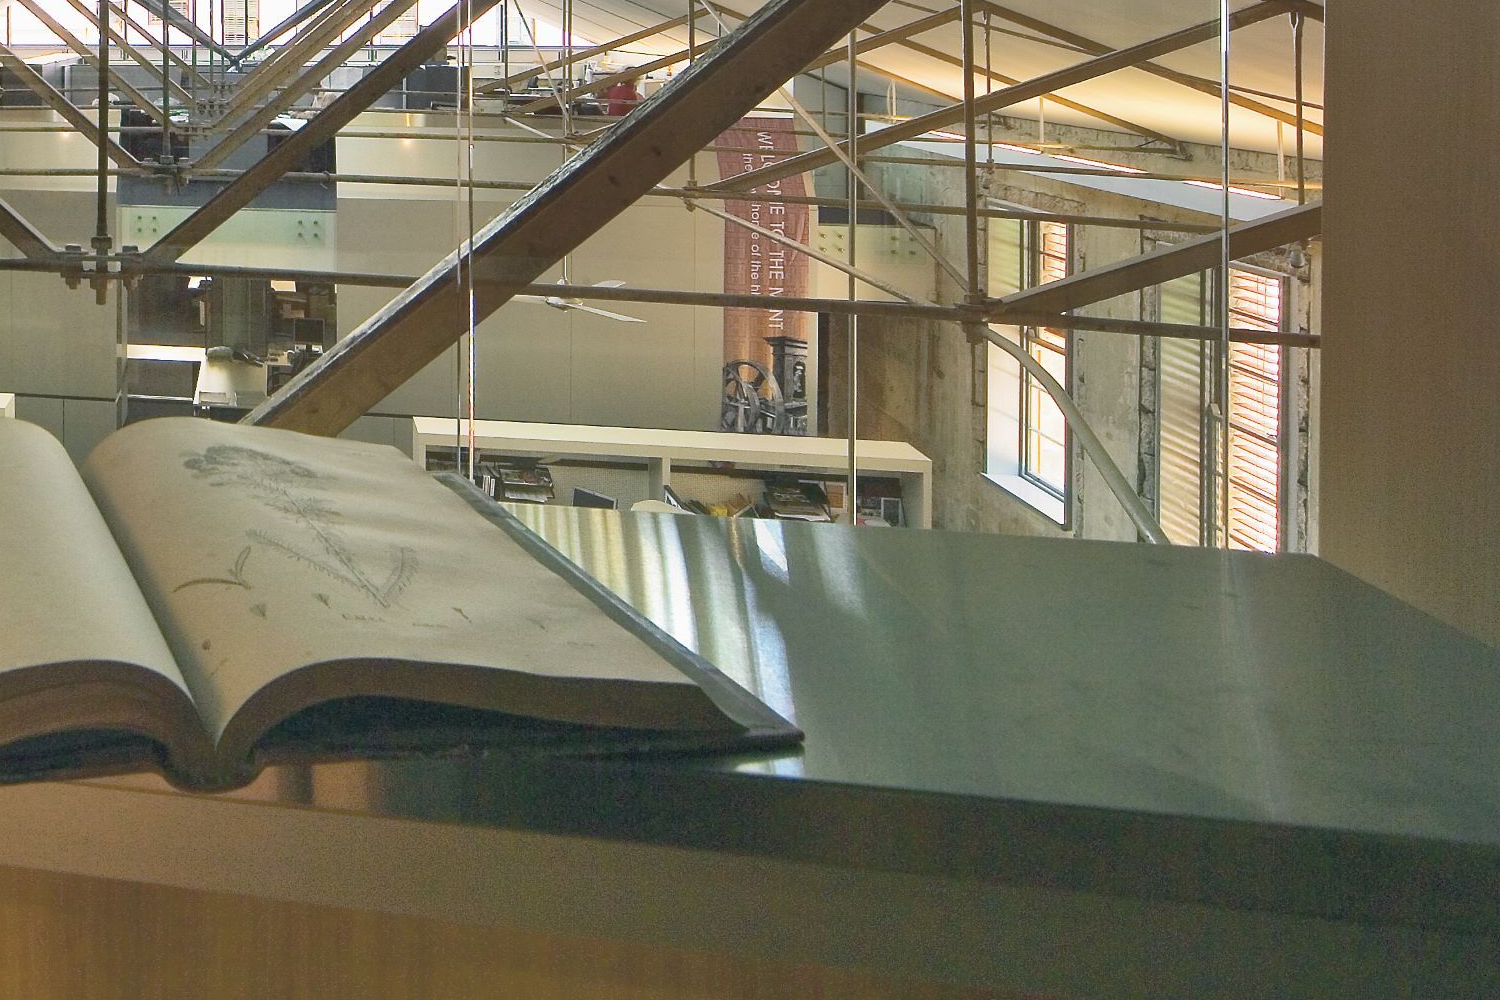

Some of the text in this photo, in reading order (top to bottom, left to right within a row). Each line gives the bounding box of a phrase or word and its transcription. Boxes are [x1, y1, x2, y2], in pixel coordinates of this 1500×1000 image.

[743, 153, 754, 172] the
[750, 244, 761, 256] of
[750, 260, 762, 280] the
[768, 250, 785, 280] THE
[768, 287, 784, 330] MNT
